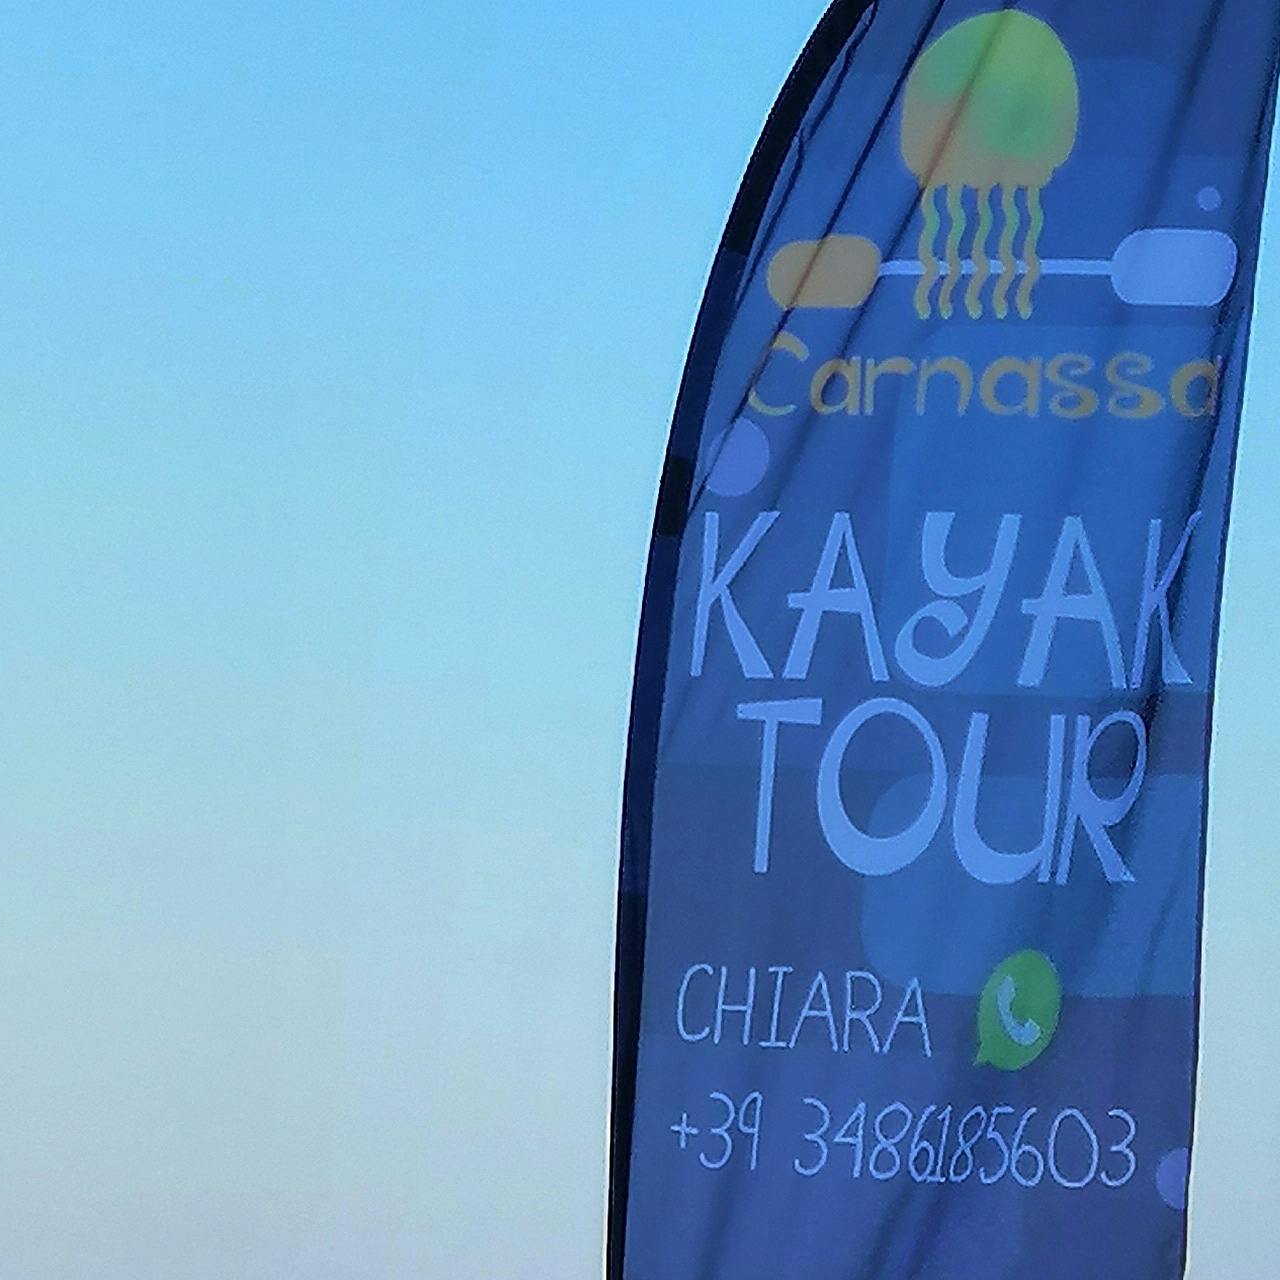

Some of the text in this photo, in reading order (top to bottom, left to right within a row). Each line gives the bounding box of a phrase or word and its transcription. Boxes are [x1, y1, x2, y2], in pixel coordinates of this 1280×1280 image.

[690, 510, 1202, 688] KAYAK
[737, 697, 1147, 885] TOUR
[676, 963, 933, 1058] CHIARA
[670, 1091, 1137, 1189] +39 3486185603
